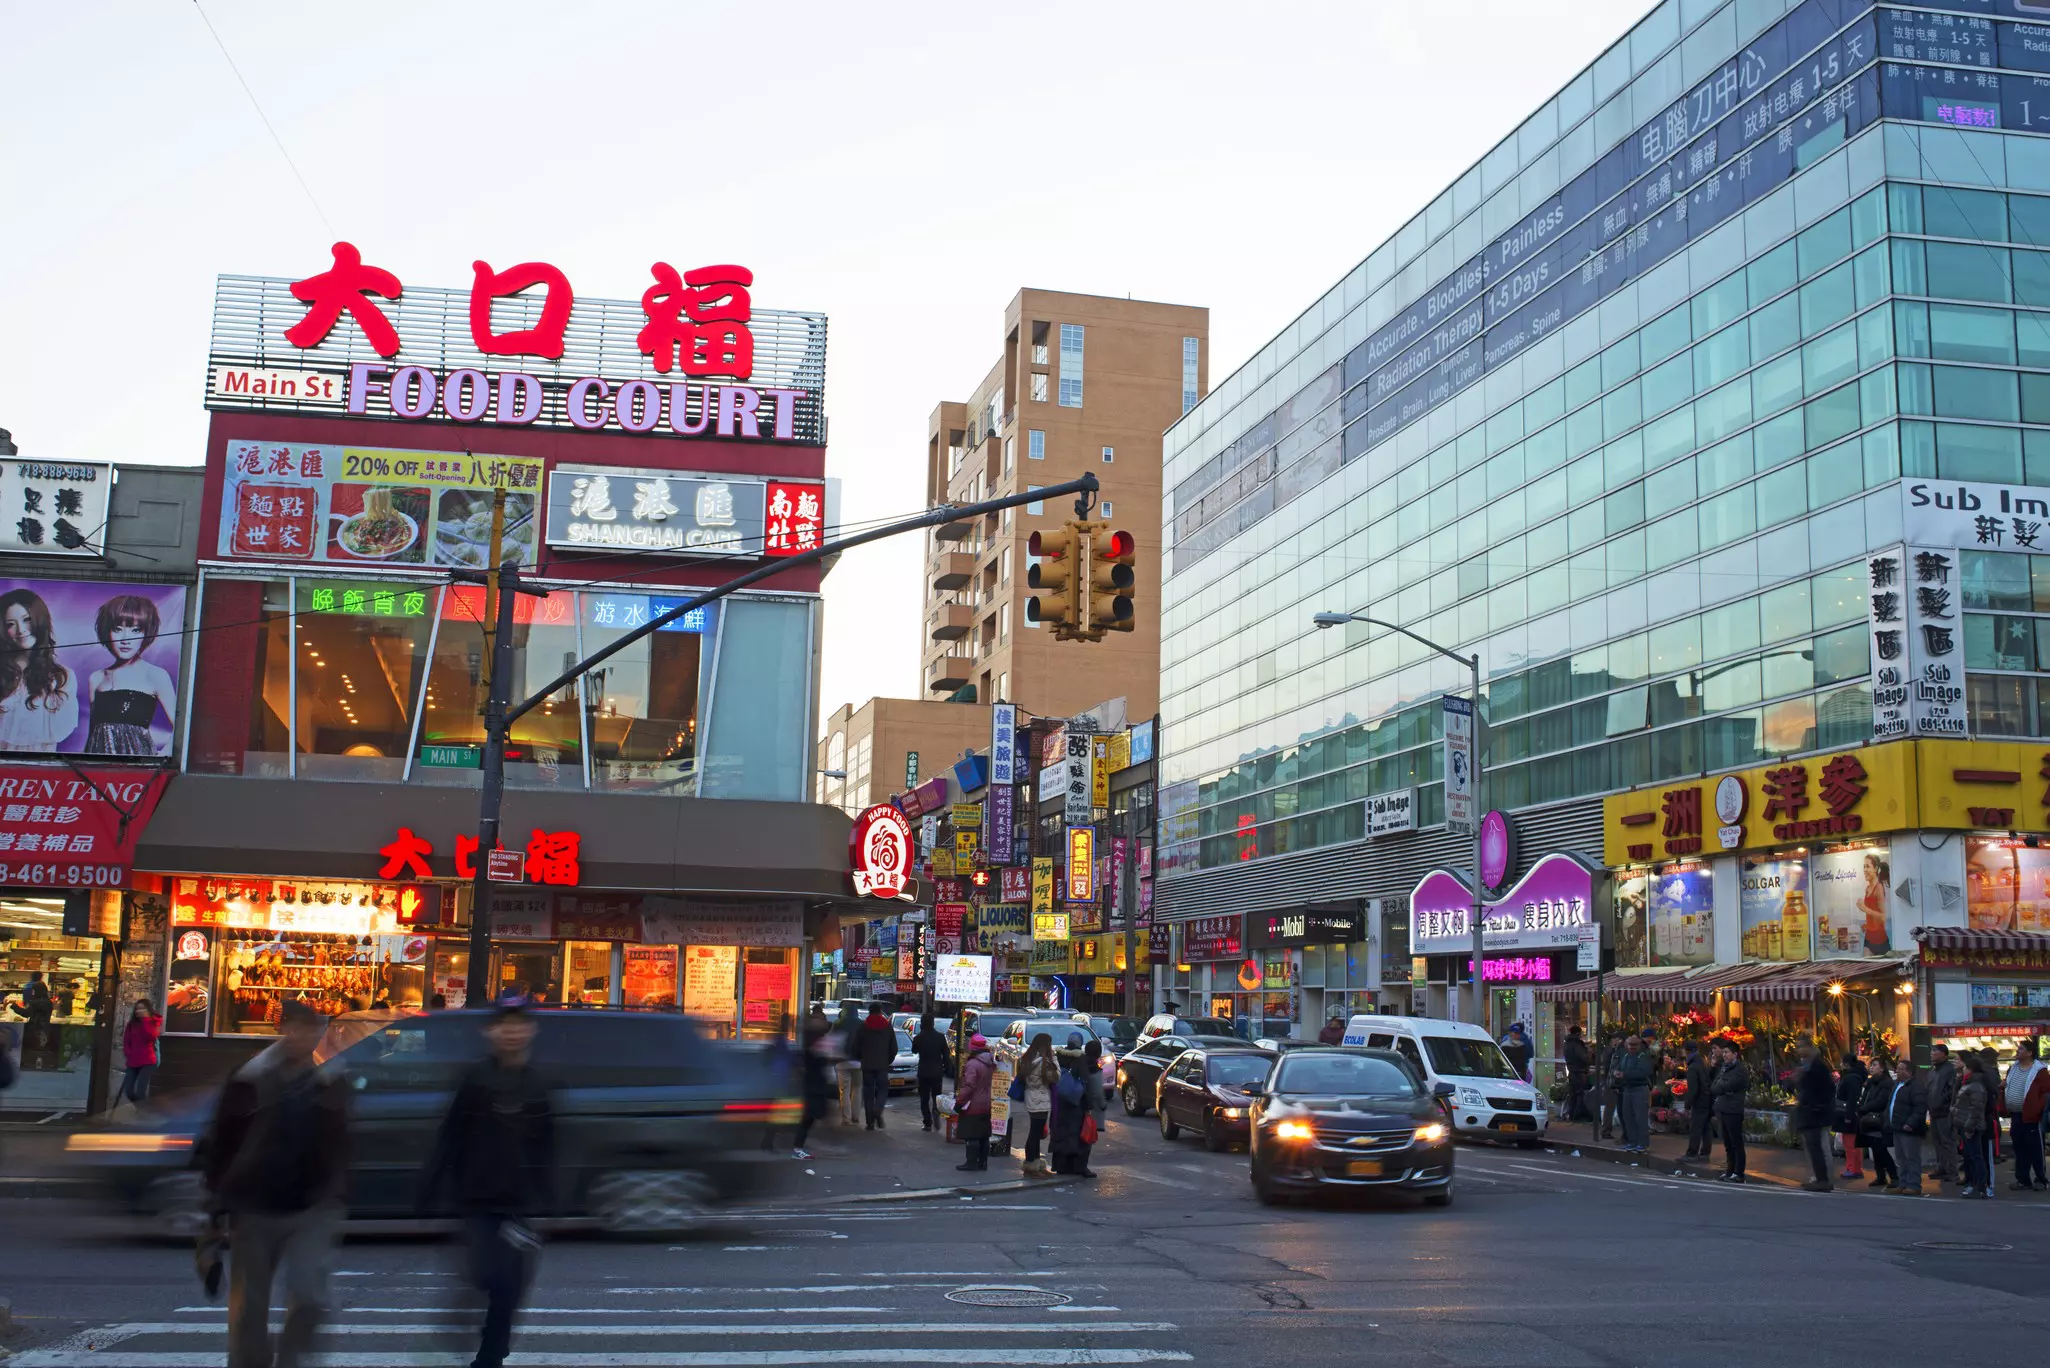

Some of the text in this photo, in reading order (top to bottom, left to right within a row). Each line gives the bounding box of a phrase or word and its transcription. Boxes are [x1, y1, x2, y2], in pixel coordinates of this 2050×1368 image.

[1951, 32, 1970, 45] 1-5
[1976, 34, 1986, 47] 天
[1812, 52, 1839, 91] 1-5
[1848, 34, 1864, 67] 天
[1368, 204, 1564, 364] Accurate Bloodless Painless
[284, 241, 755, 379] 大口福
[1377, 261, 1549, 396] Radiation Therapy 1-5 Days
[1439, 349, 1470, 377] Tumors
[1368, 307, 1561, 443] Prostate Brain Lung Liver Pancreas Spine
[225, 363, 808, 440] Main St FOOD COURT
[346, 456, 419, 476] 20% OFF
[468, 460, 542, 487] 八折優惠
[419, 472, 466, 483] Soft-Opening
[1911, 484, 1981, 511] Sub
[245, 524, 302, 548] 世家
[568, 523, 742, 550] SHANGHAI CAFE
[453, 594, 565, 622] 廣小炒
[1878, 667, 1896, 686] Sub
[1927, 664, 1950, 683] Sub
[1874, 687, 1904, 706] Image
[1919, 682, 1961, 701] Image
[1883, 711, 1894, 719] 718
[1933, 708, 1949, 716] 718
[1875, 719, 1905, 736] 661-1116
[1921, 718, 1964, 731] 661-1116
[431, 750, 471, 764] MAIN ST
[0, 778, 144, 803] REN TANG
[1621, 755, 1868, 837] 一洲 洋參
[0, 804, 82, 824] 醫駐診
[1067, 803, 1088, 812] Hair Salon
[1374, 796, 1409, 814] Sub Image
[868, 807, 910, 836] HAPPY FOOD
[1967, 806, 2015, 826] YAT
[1627, 814, 1862, 859] YAT CHAU GINSENG
[1719, 826, 1740, 836] Yat Chau
[0, 863, 122, 885] 8-461-9500
[863, 872, 899, 888] 大口福
[1743, 876, 1781, 890] SOLGAR
[1007, 890, 1027, 899] SALON
[1075, 885, 1086, 894] 24
[980, 907, 1025, 926] LIQUORS
[1551, 935, 1559, 943] Tel:
[1344, 1036, 1365, 1045] ECOLAB
